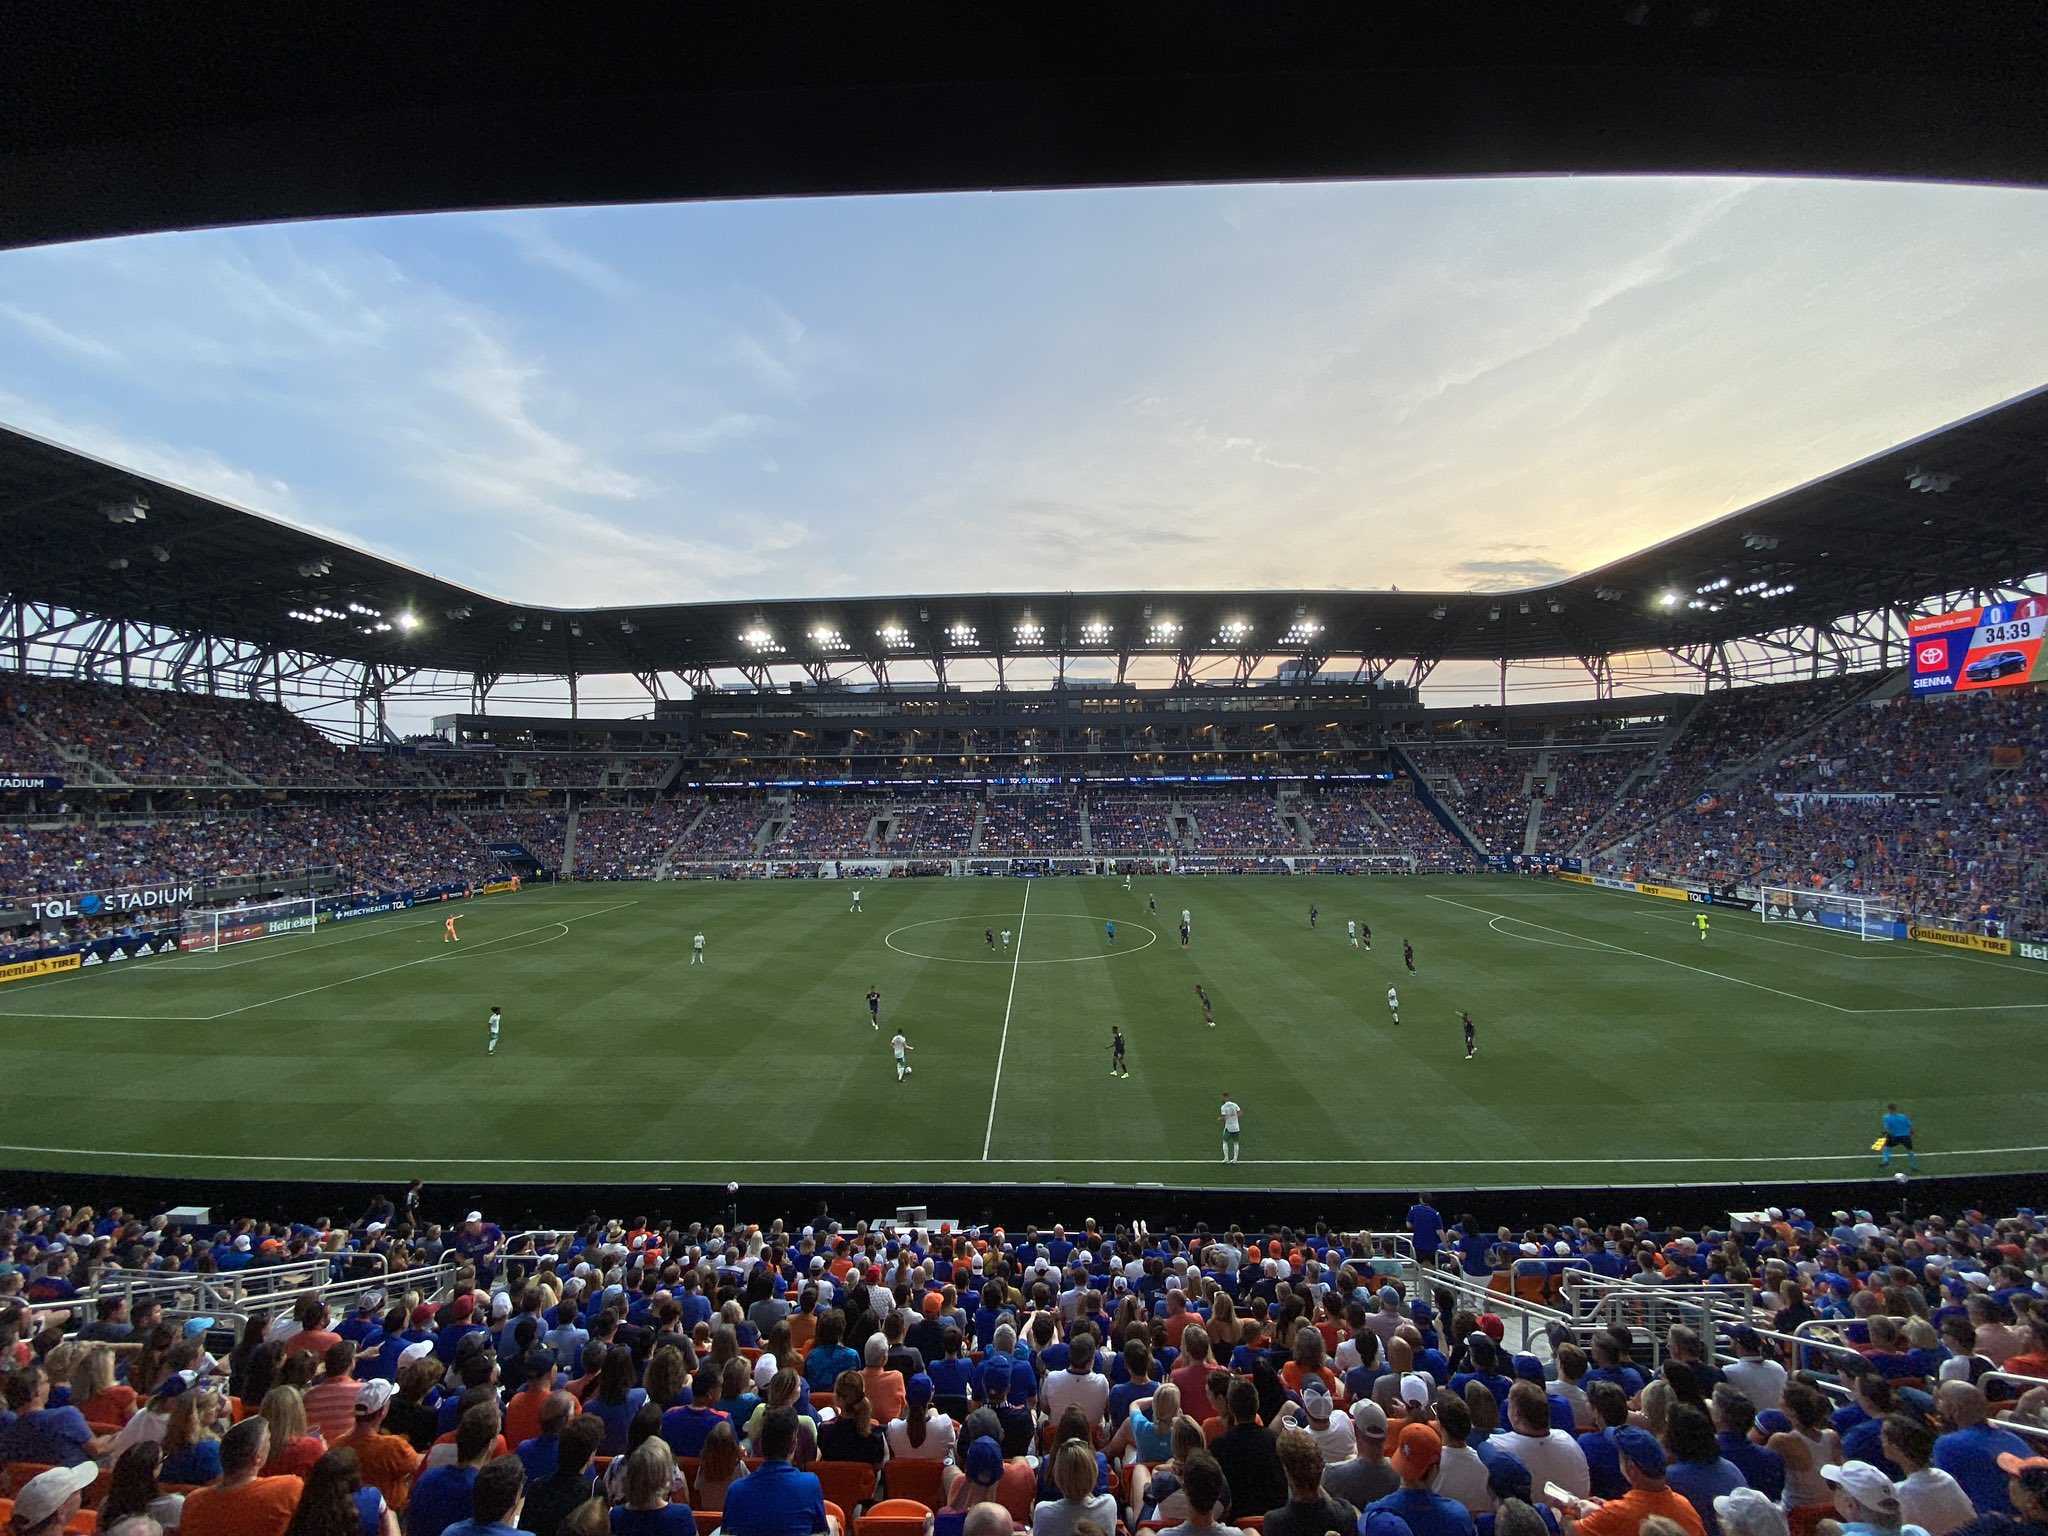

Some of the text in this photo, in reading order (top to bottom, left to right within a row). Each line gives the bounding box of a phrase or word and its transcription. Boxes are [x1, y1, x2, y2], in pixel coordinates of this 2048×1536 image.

[2026, 601, 2037, 618] 1
[1985, 622, 2031, 643] 34:39
[1913, 675, 1953, 689] SIENNA
[31, 886, 193, 920] TQL STADIUM
[1689, 892, 1704, 903] TQL
[392, 901, 407, 911] TQL
[1909, 926, 2007, 952] Continental TIRE
[50, 957, 78, 970] TIRE
